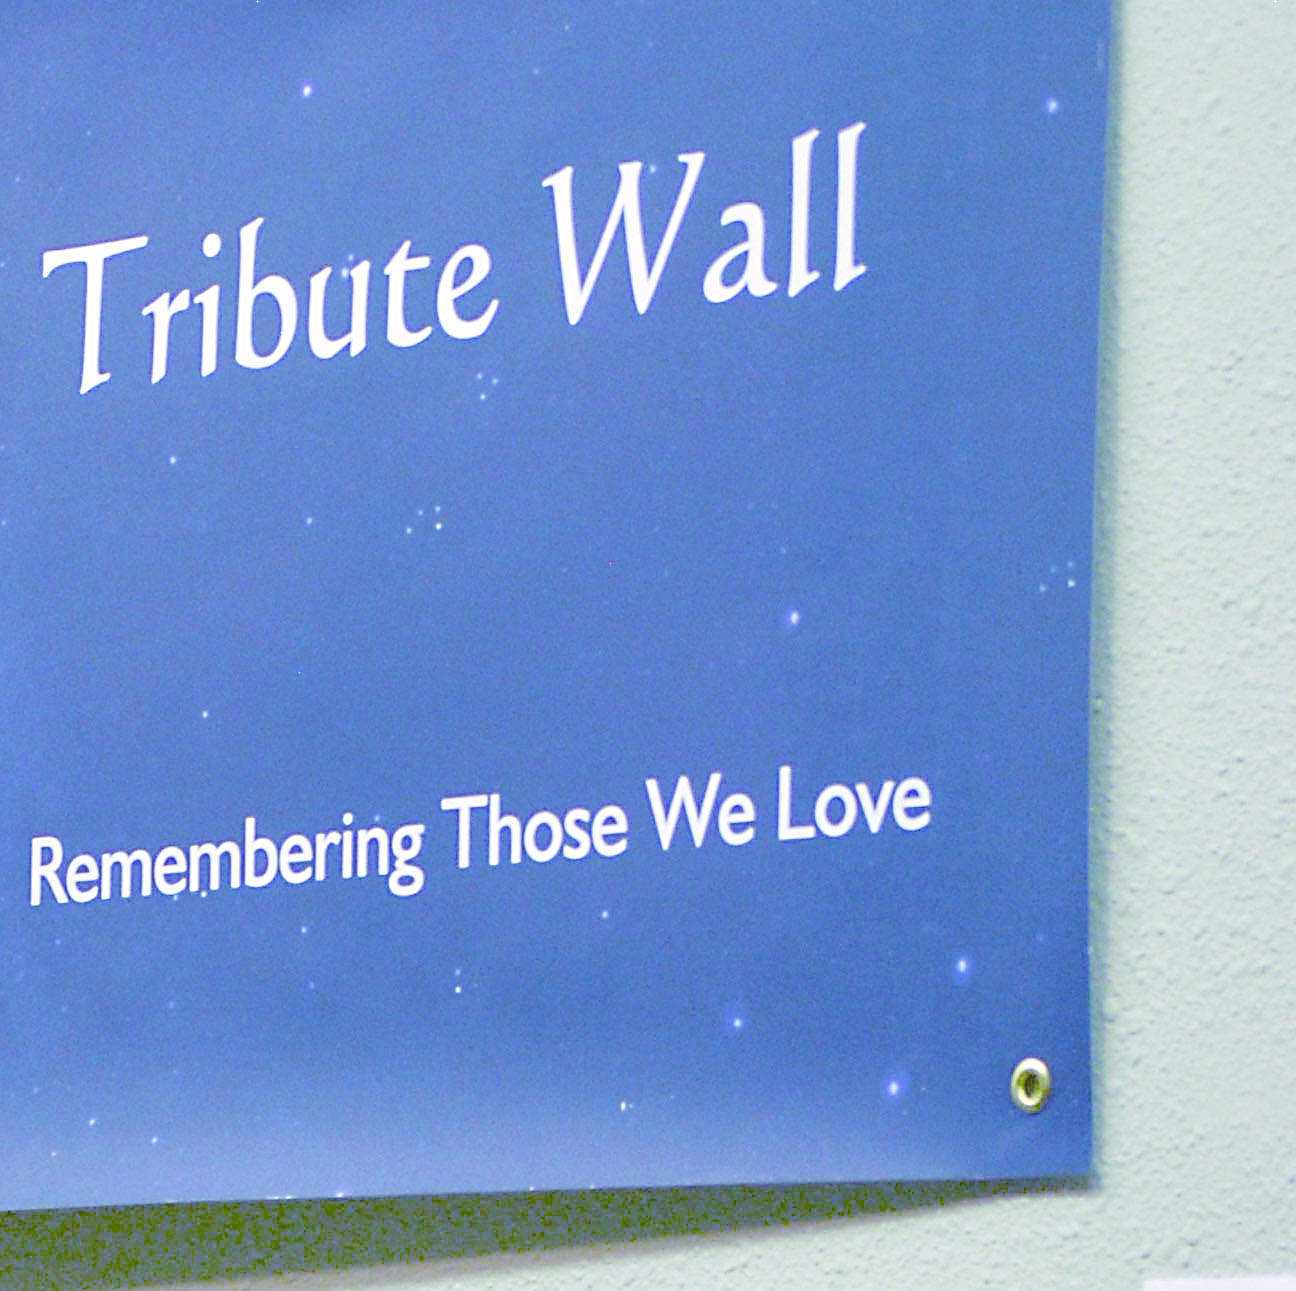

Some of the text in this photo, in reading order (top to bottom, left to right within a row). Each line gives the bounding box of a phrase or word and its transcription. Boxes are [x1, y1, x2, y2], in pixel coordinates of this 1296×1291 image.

[43, 123, 866, 394] Tribute Wall
[31, 766, 930, 905] Remembering Those We Love
